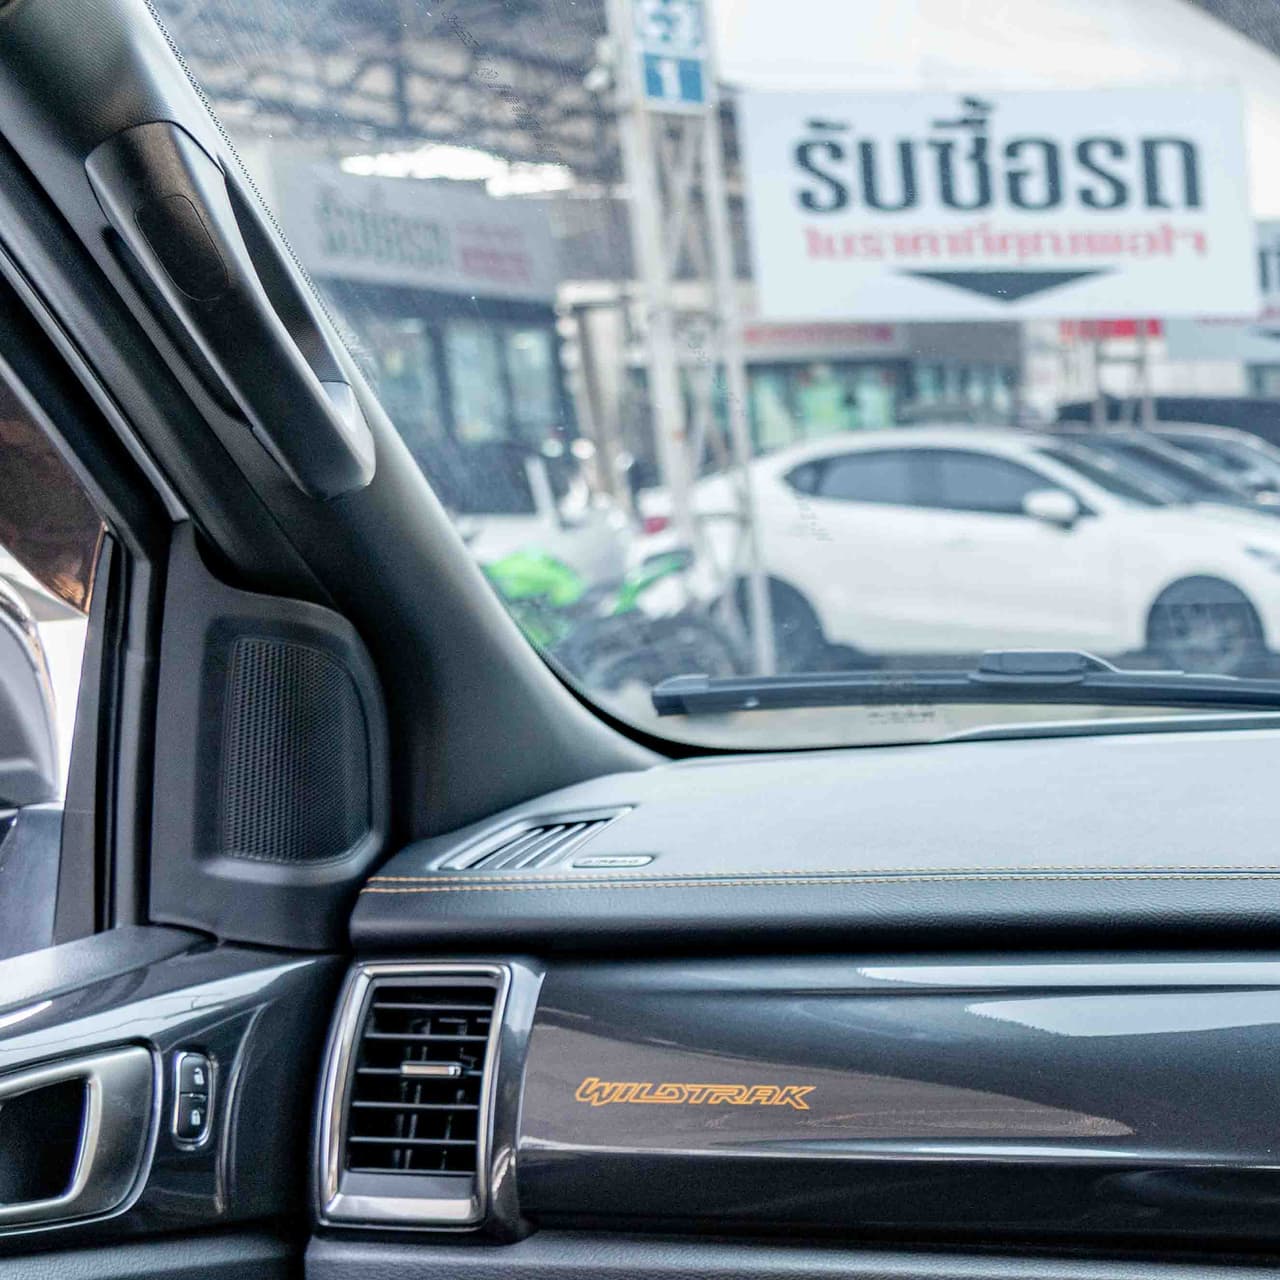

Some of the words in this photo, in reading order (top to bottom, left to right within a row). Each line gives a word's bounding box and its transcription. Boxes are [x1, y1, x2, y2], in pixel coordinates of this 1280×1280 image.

[792, 95, 1205, 212] รับซื้อรถ
[575, 1077, 817, 1110] WILDTRAK
